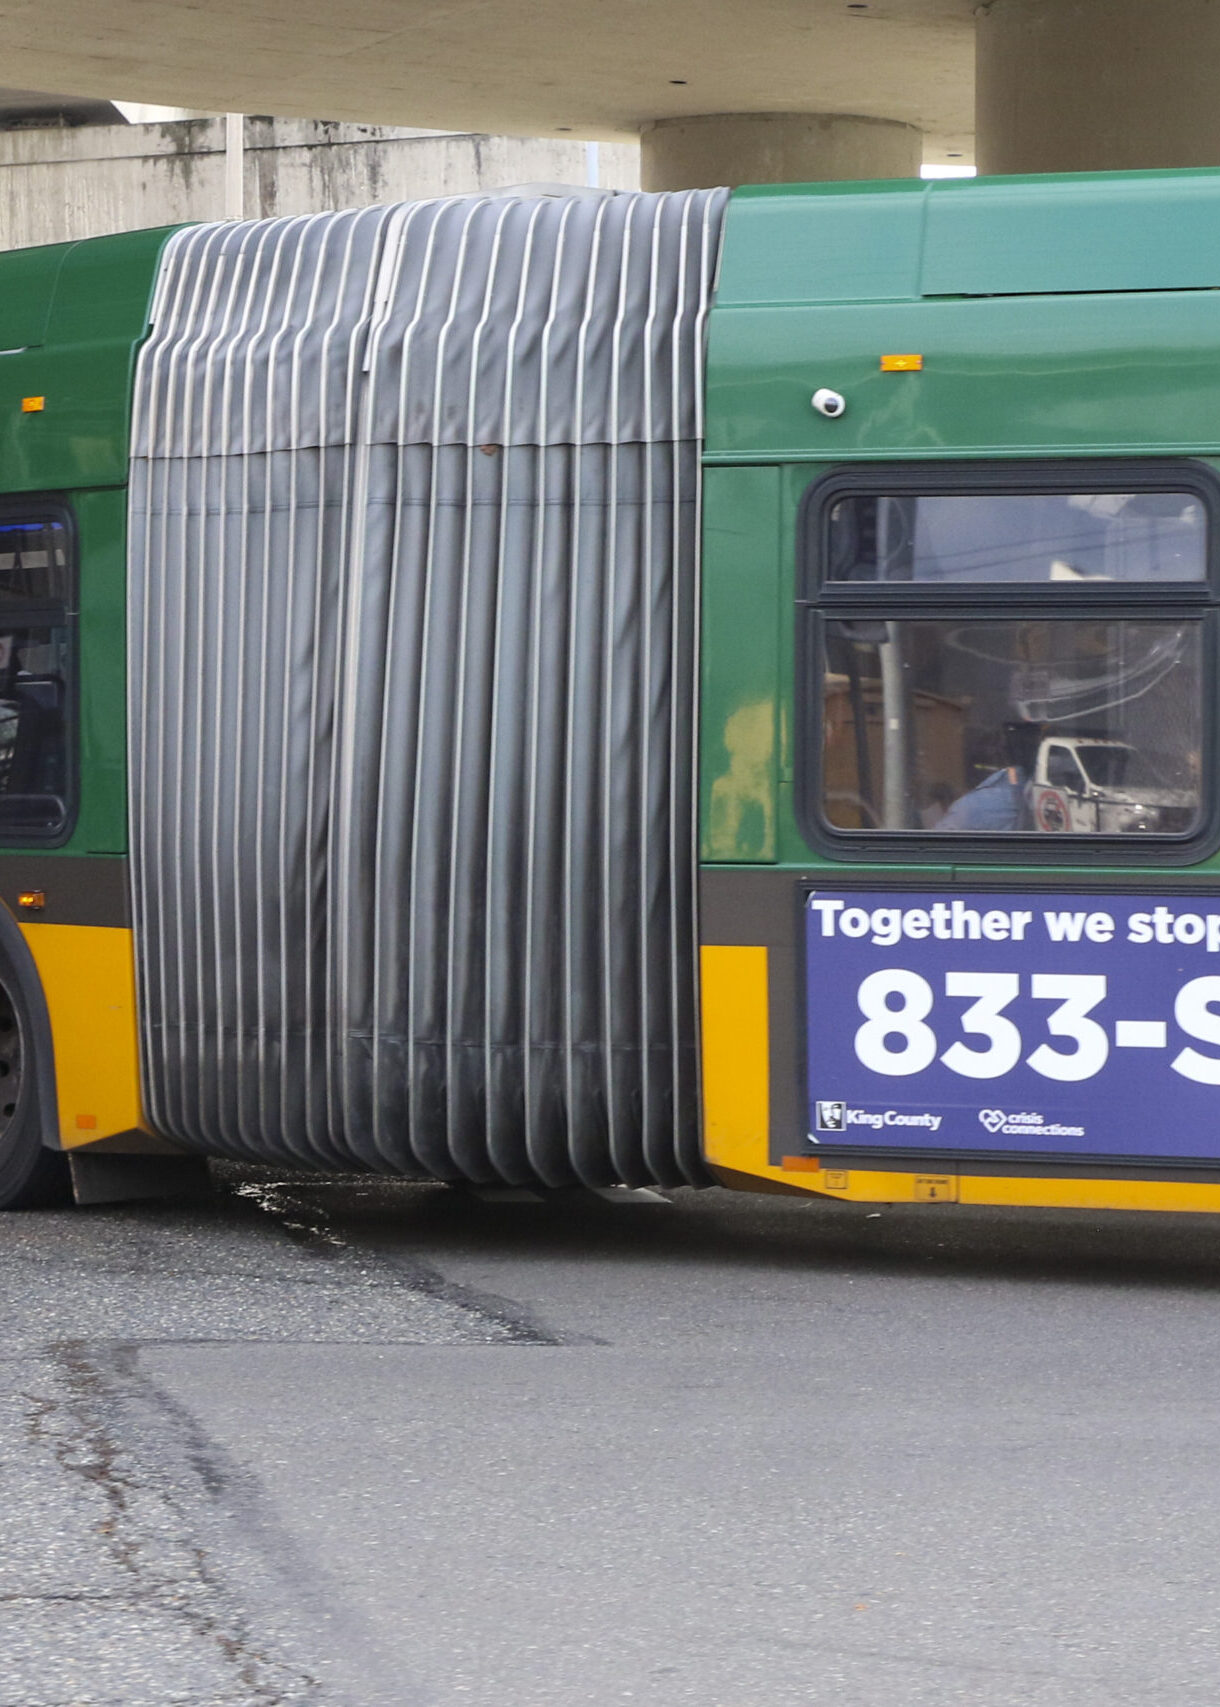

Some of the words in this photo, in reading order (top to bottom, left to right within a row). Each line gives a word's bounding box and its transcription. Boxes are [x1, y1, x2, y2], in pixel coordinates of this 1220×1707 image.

[811, 899, 1032, 946] Together
[1044, 910, 1115, 943] we
[846, 1109, 884, 1130] King
[884, 1110, 943, 1132] County
[1007, 1111, 1044, 1125] crisis
[1002, 1122, 1085, 1137] connections
